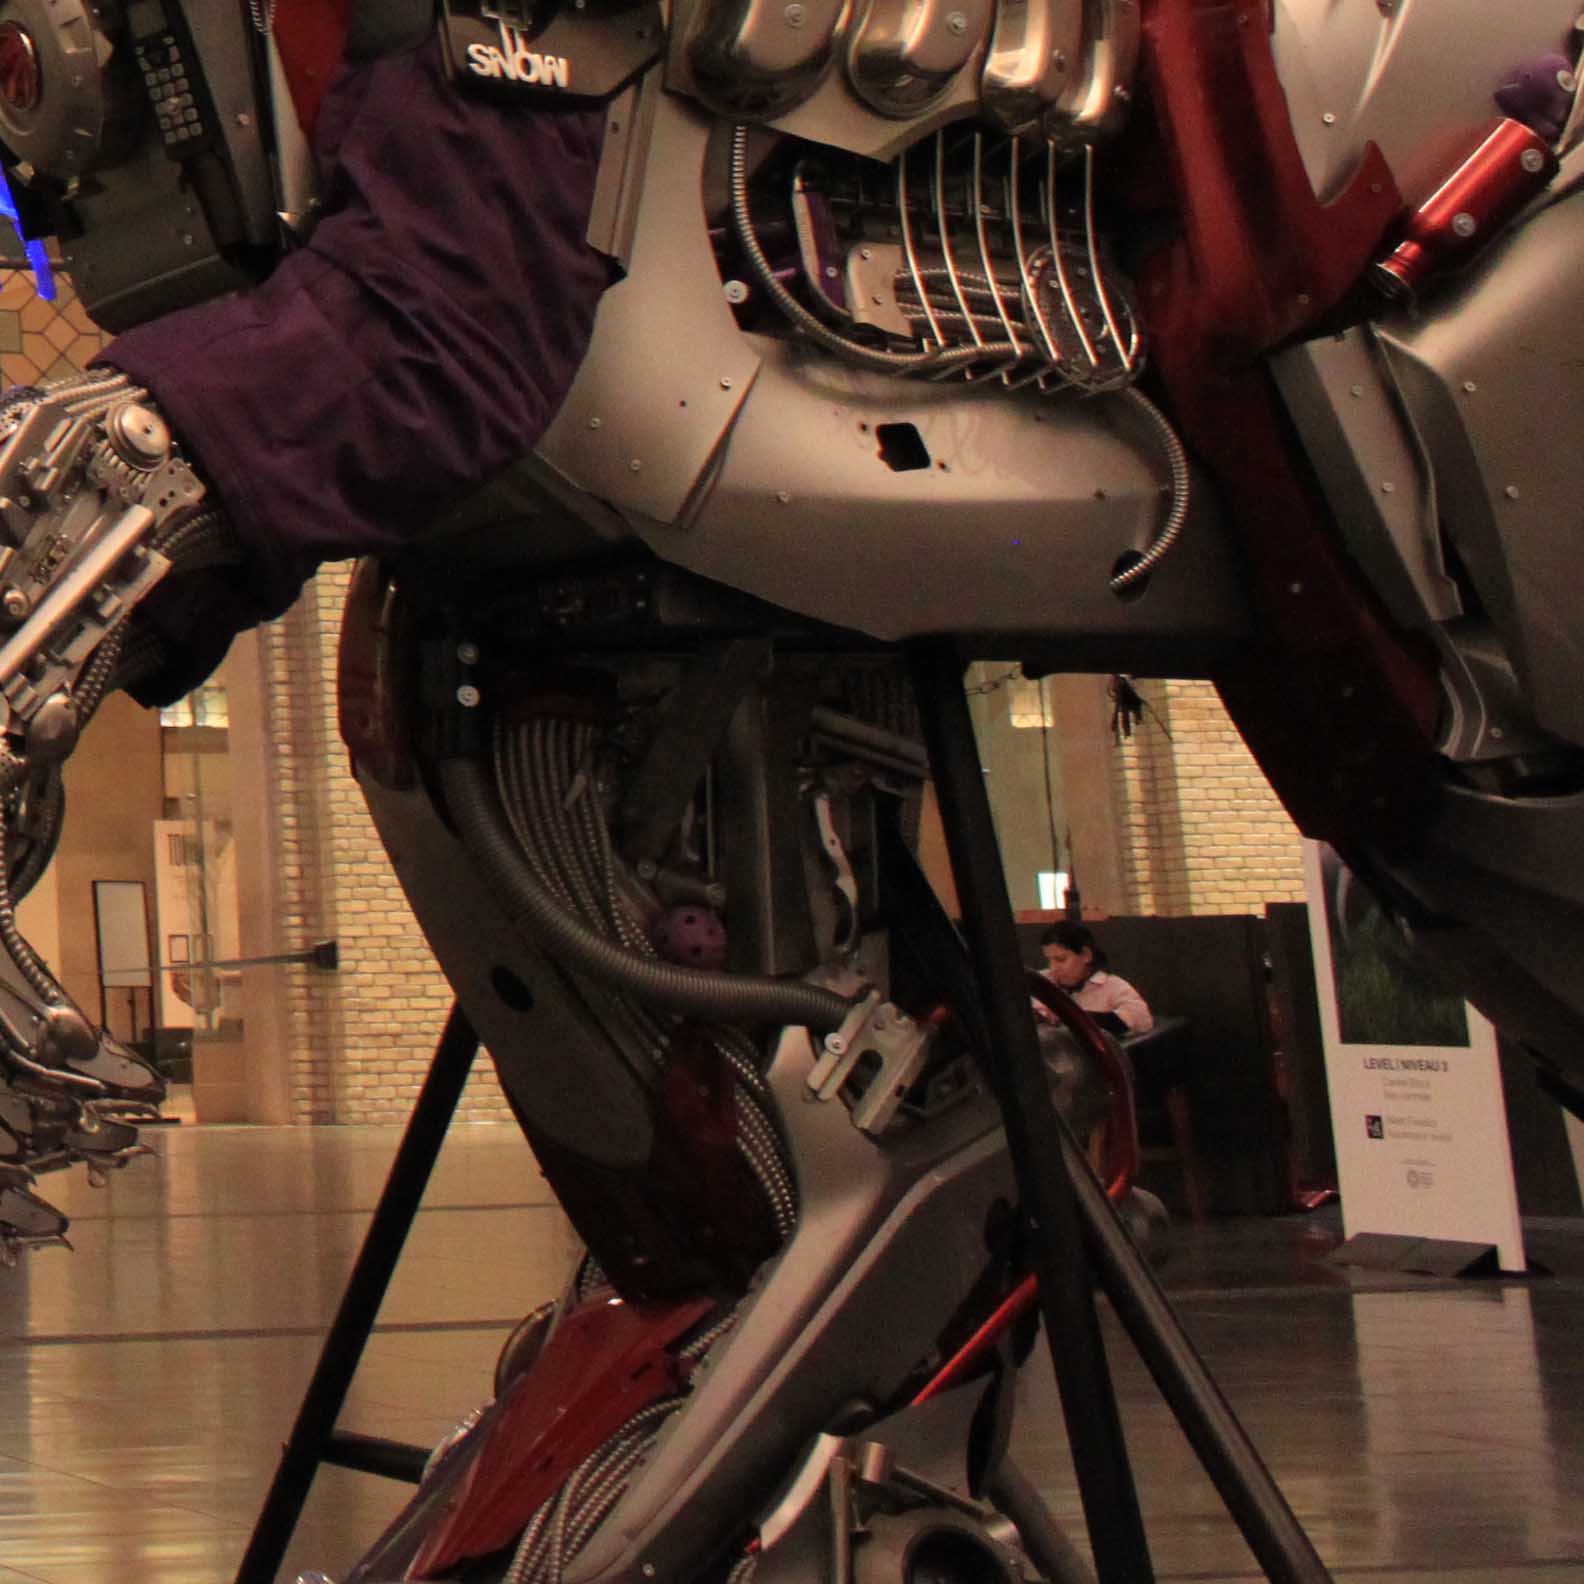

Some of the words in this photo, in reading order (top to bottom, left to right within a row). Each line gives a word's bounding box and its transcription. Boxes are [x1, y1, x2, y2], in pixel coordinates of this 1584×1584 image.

[467, 43, 570, 88] SNOW
[1363, 1057, 1396, 1071] LEVEL
[1401, 1059, 1440, 1072] NIVEAU
